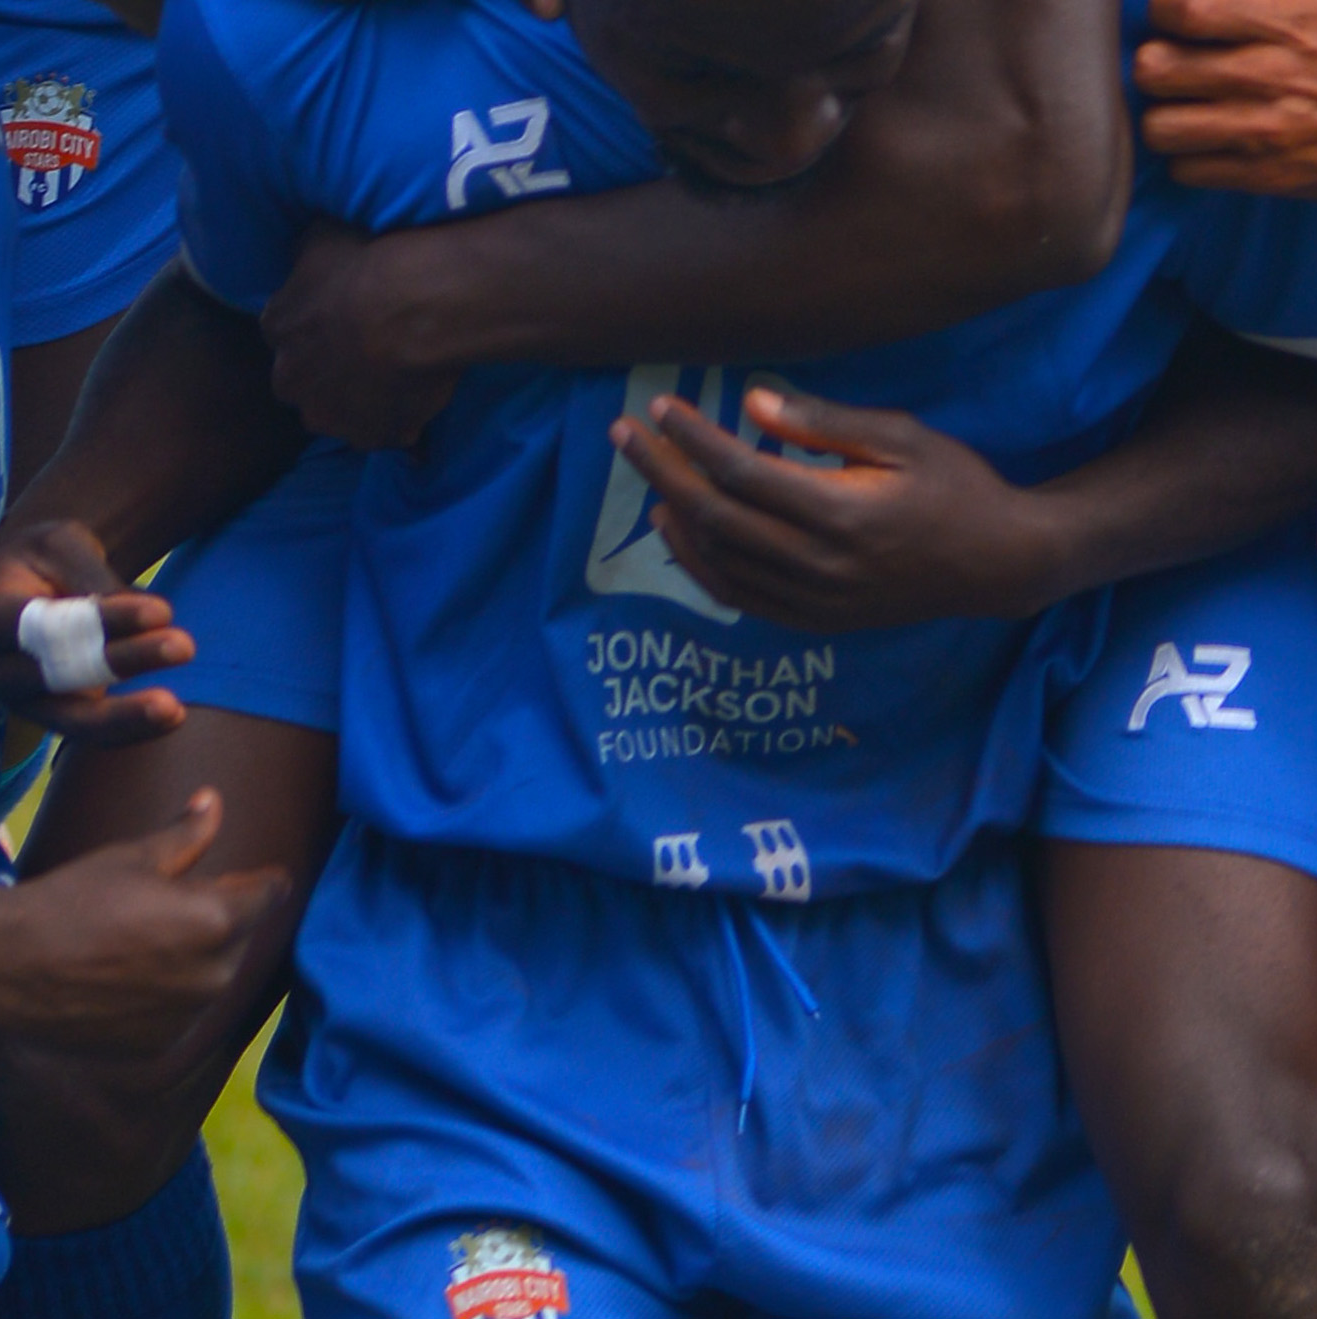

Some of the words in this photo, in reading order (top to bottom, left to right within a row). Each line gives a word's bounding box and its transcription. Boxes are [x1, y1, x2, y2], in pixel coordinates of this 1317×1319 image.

[59, 132, 95, 159] CITY
[446, 96, 571, 211] AZ
[586, 629, 835, 686] JONATHAN
[603, 673, 816, 723] JACKSON
[1127, 641, 1257, 731] AZ
[598, 723, 835, 765] FOUNDATION
